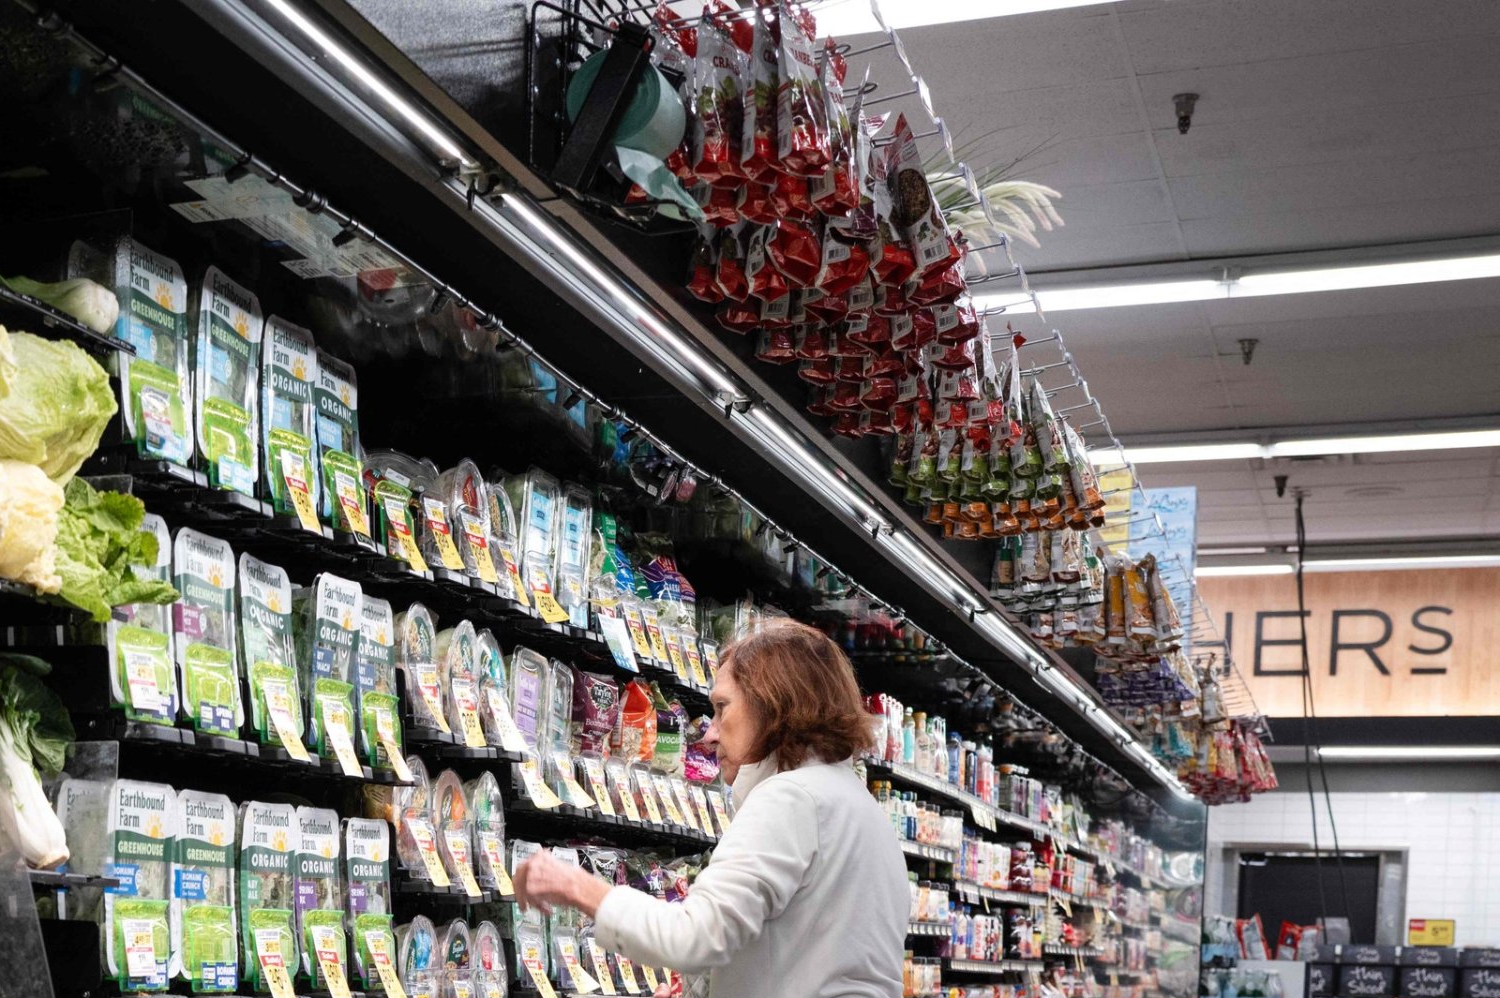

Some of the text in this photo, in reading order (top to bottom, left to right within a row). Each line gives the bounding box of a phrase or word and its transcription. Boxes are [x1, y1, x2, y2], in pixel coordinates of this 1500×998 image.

[130, 249, 174, 284] Earthbound
[130, 269, 150, 292] Farm
[131, 298, 175, 330] GREENHOUSE
[212, 293, 230, 318] Farm
[211, 323, 249, 358] GREENHOUSE
[273, 326, 308, 356] Earthbound
[273, 346, 290, 366] Farm
[272, 372, 309, 399] ORGANIC
[320, 370, 337, 392] Farm
[321, 396, 353, 425] ORGANIC
[187, 584, 224, 605] GREENHOUSE
[250, 604, 285, 629] ORGANIC
[320, 627, 354, 647] ORGANIC
[359, 642, 389, 660] ORGANIC
[120, 789, 165, 811] Earthbound
[185, 798, 224, 820] Earthbound
[119, 808, 140, 828] Farm
[186, 817, 204, 836] Farm
[253, 806, 290, 827] Earthbound
[300, 818, 333, 835] Earthbound
[253, 826, 268, 843] Farm
[351, 823, 381, 839] Earthbound
[118, 840, 163, 856] GREENHOUSE
[301, 836, 317, 850] Farm
[353, 841, 366, 855] Farm
[186, 848, 226, 863] GREENHOUSE
[251, 853, 288, 868] ORGANIC
[302, 860, 334, 875] ORGANIC
[353, 864, 383, 877] ORGANIC
[1347, 980, 1387, 996] Sliced
[1408, 982, 1448, 997] Sliced
